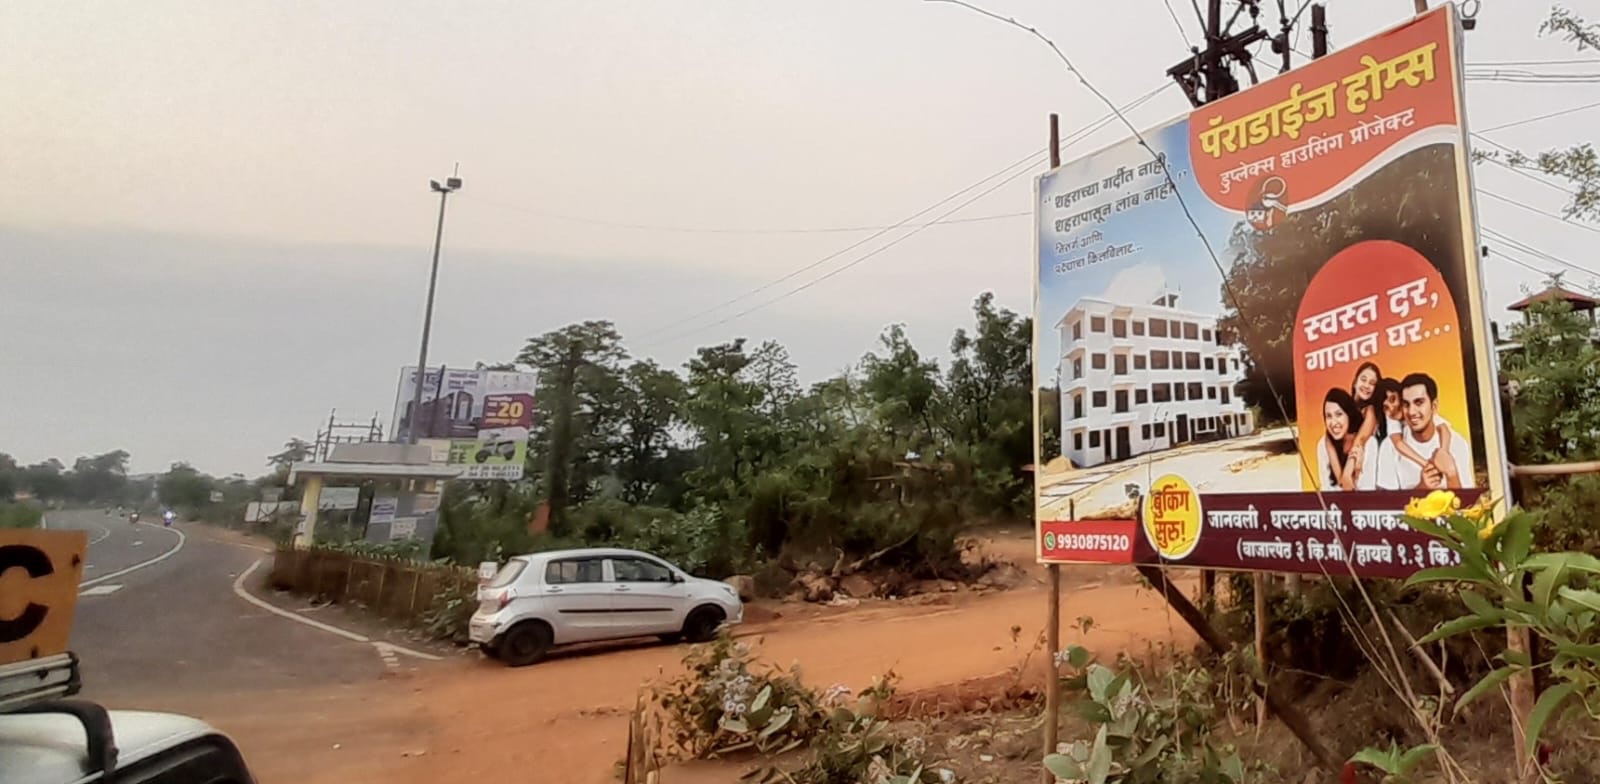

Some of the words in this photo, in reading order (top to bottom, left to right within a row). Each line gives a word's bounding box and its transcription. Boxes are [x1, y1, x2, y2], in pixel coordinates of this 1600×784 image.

[1199, 83, 1337, 158] पॅराडाईज
[1342, 42, 1437, 114] होम्स
[1220, 157, 1275, 193] डुप्लेक्स
[1281, 132, 1343, 167] हाउसिंग
[1349, 108, 1415, 145] प्रोजेक्ट
[1103, 166, 1135, 191] गर्दीत
[1054, 202, 1112, 232] शहरापासून
[1115, 191, 1140, 212] लांब
[1302, 295, 1379, 342] स्वस्त
[1386, 277, 1439, 318] दर,
[1305, 332, 1379, 370] गावात
[1386, 318, 1450, 347] घर...
[496, 401, 524, 419] 20
[1151, 483, 1190, 518] बुकिंग
[1057, 533, 1129, 551] 9930875120
[1152, 520, 1187, 549] सुरु!
[1295, 541, 1305, 562] ३
